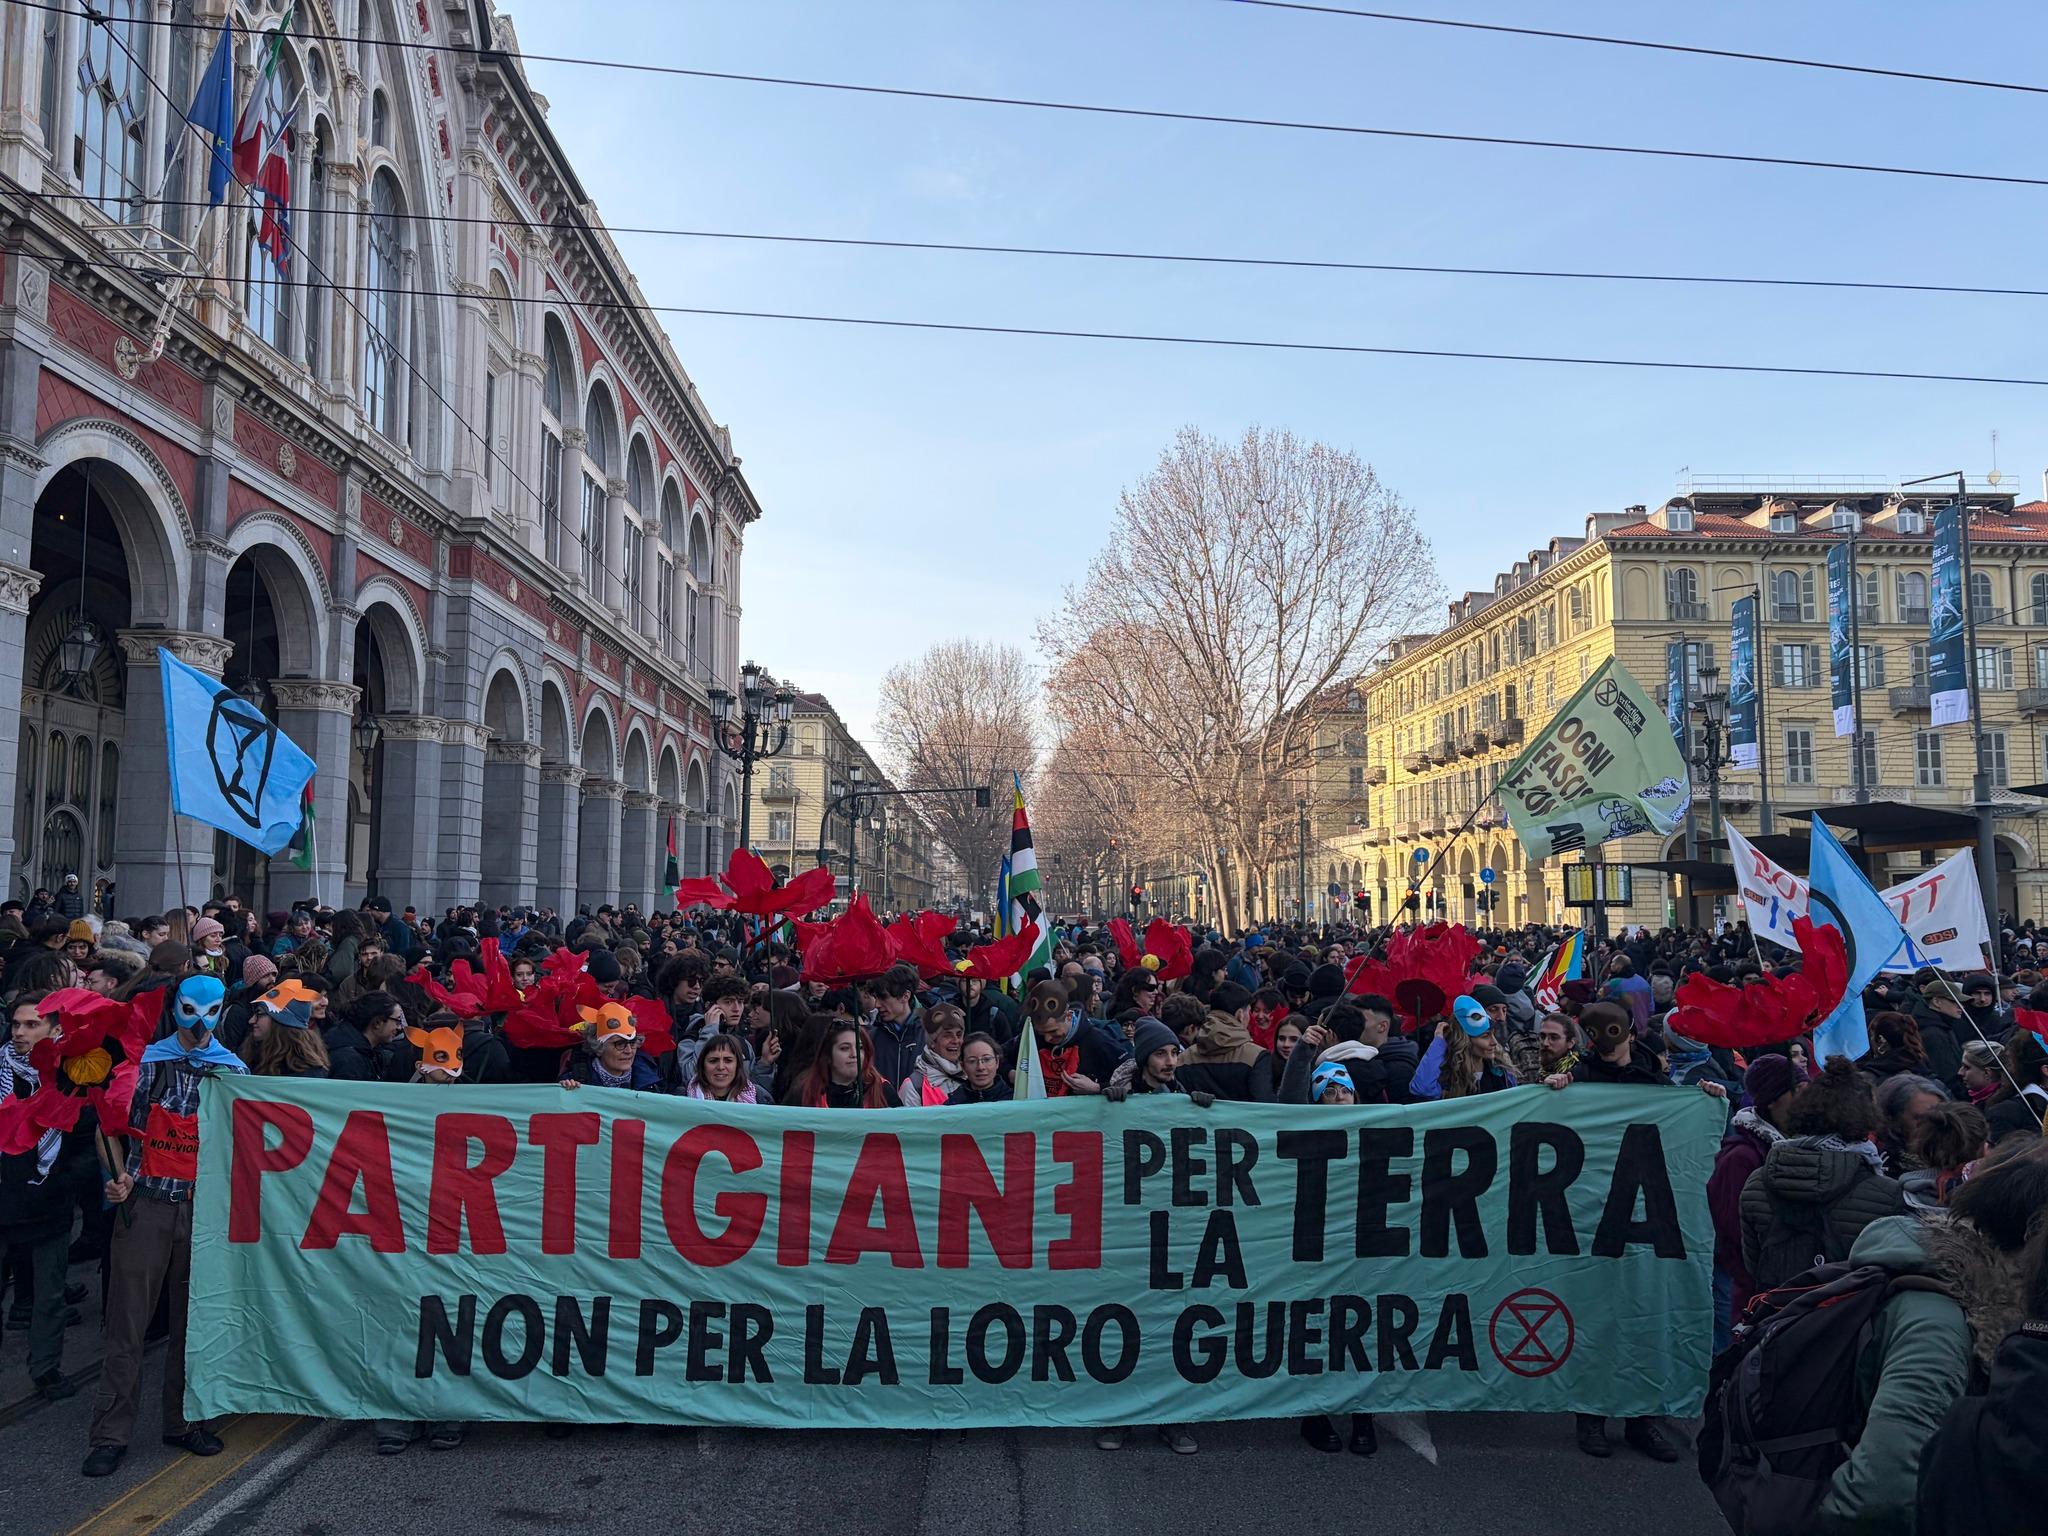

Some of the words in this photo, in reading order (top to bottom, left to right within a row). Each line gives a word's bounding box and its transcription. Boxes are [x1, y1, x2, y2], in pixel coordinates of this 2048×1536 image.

[1557, 717, 1615, 778] OGNI
[1122, 1127, 1262, 1207] PER
[1277, 1121, 1687, 1262] TERRA
[1149, 1209, 1249, 1290] LA
[414, 1294, 612, 1380] NON
[635, 1299, 774, 1383] PER
[803, 1304, 899, 1385] LA
[928, 1302, 1141, 1385] LORO
[1172, 1293, 1479, 1385] GUERRA
